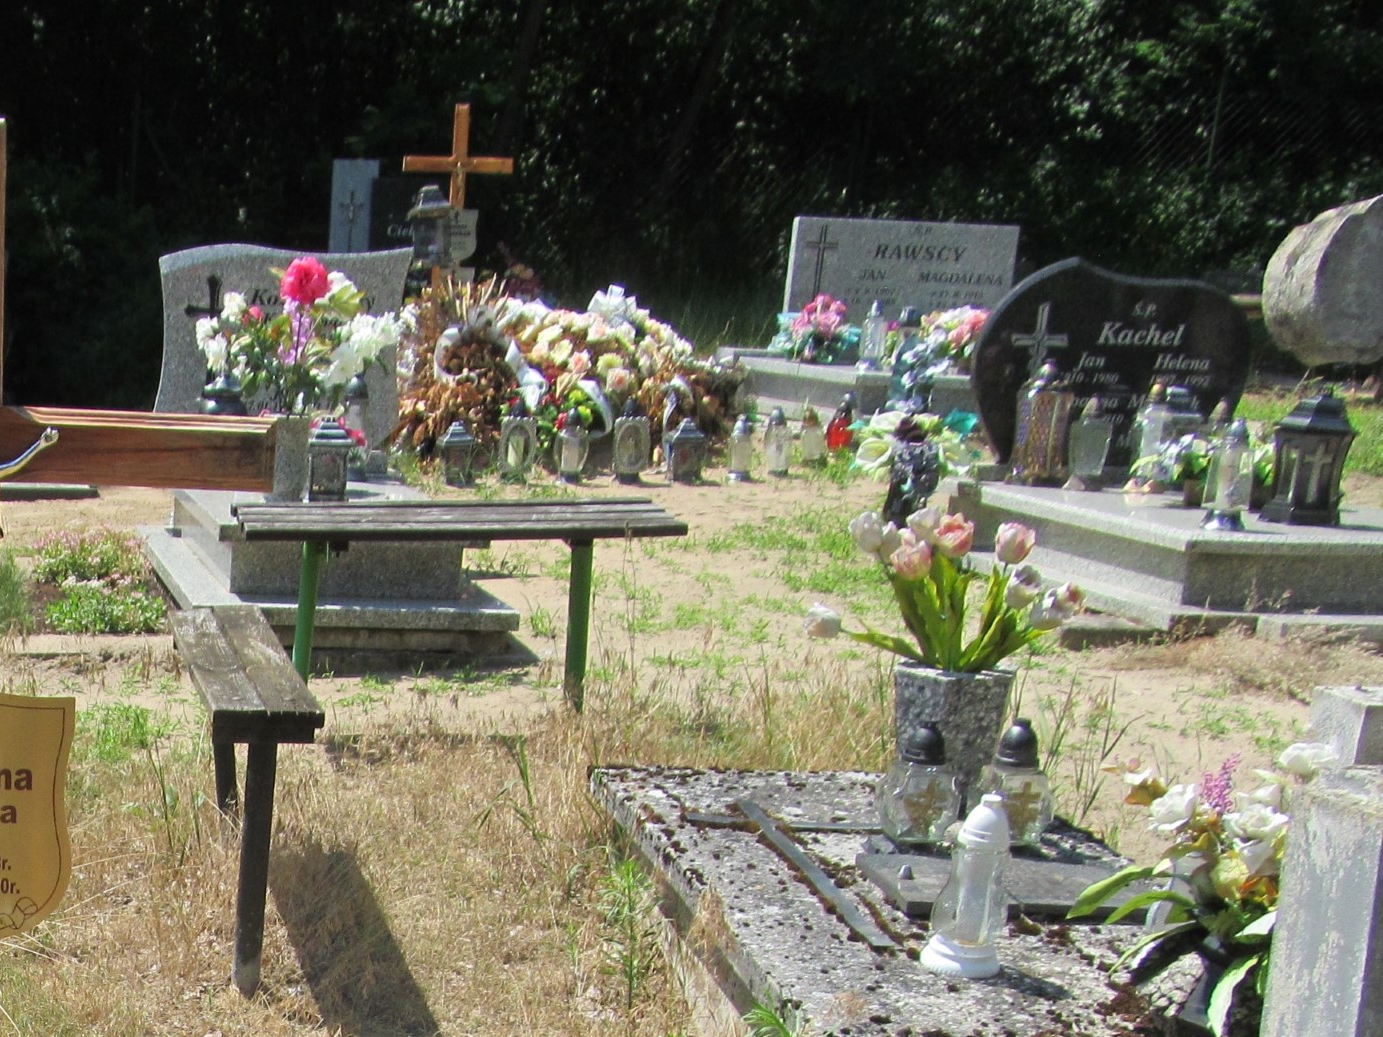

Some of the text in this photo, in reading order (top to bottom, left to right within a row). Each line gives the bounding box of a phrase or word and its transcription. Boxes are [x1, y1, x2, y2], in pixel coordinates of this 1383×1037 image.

[874, 243, 968, 263] RAWSCY
[859, 269, 887, 281] JAN
[1096, 321, 1186, 347] Kachel
[1073, 352, 1106, 371] Jan
[1154, 354, 1211, 371] Helena
